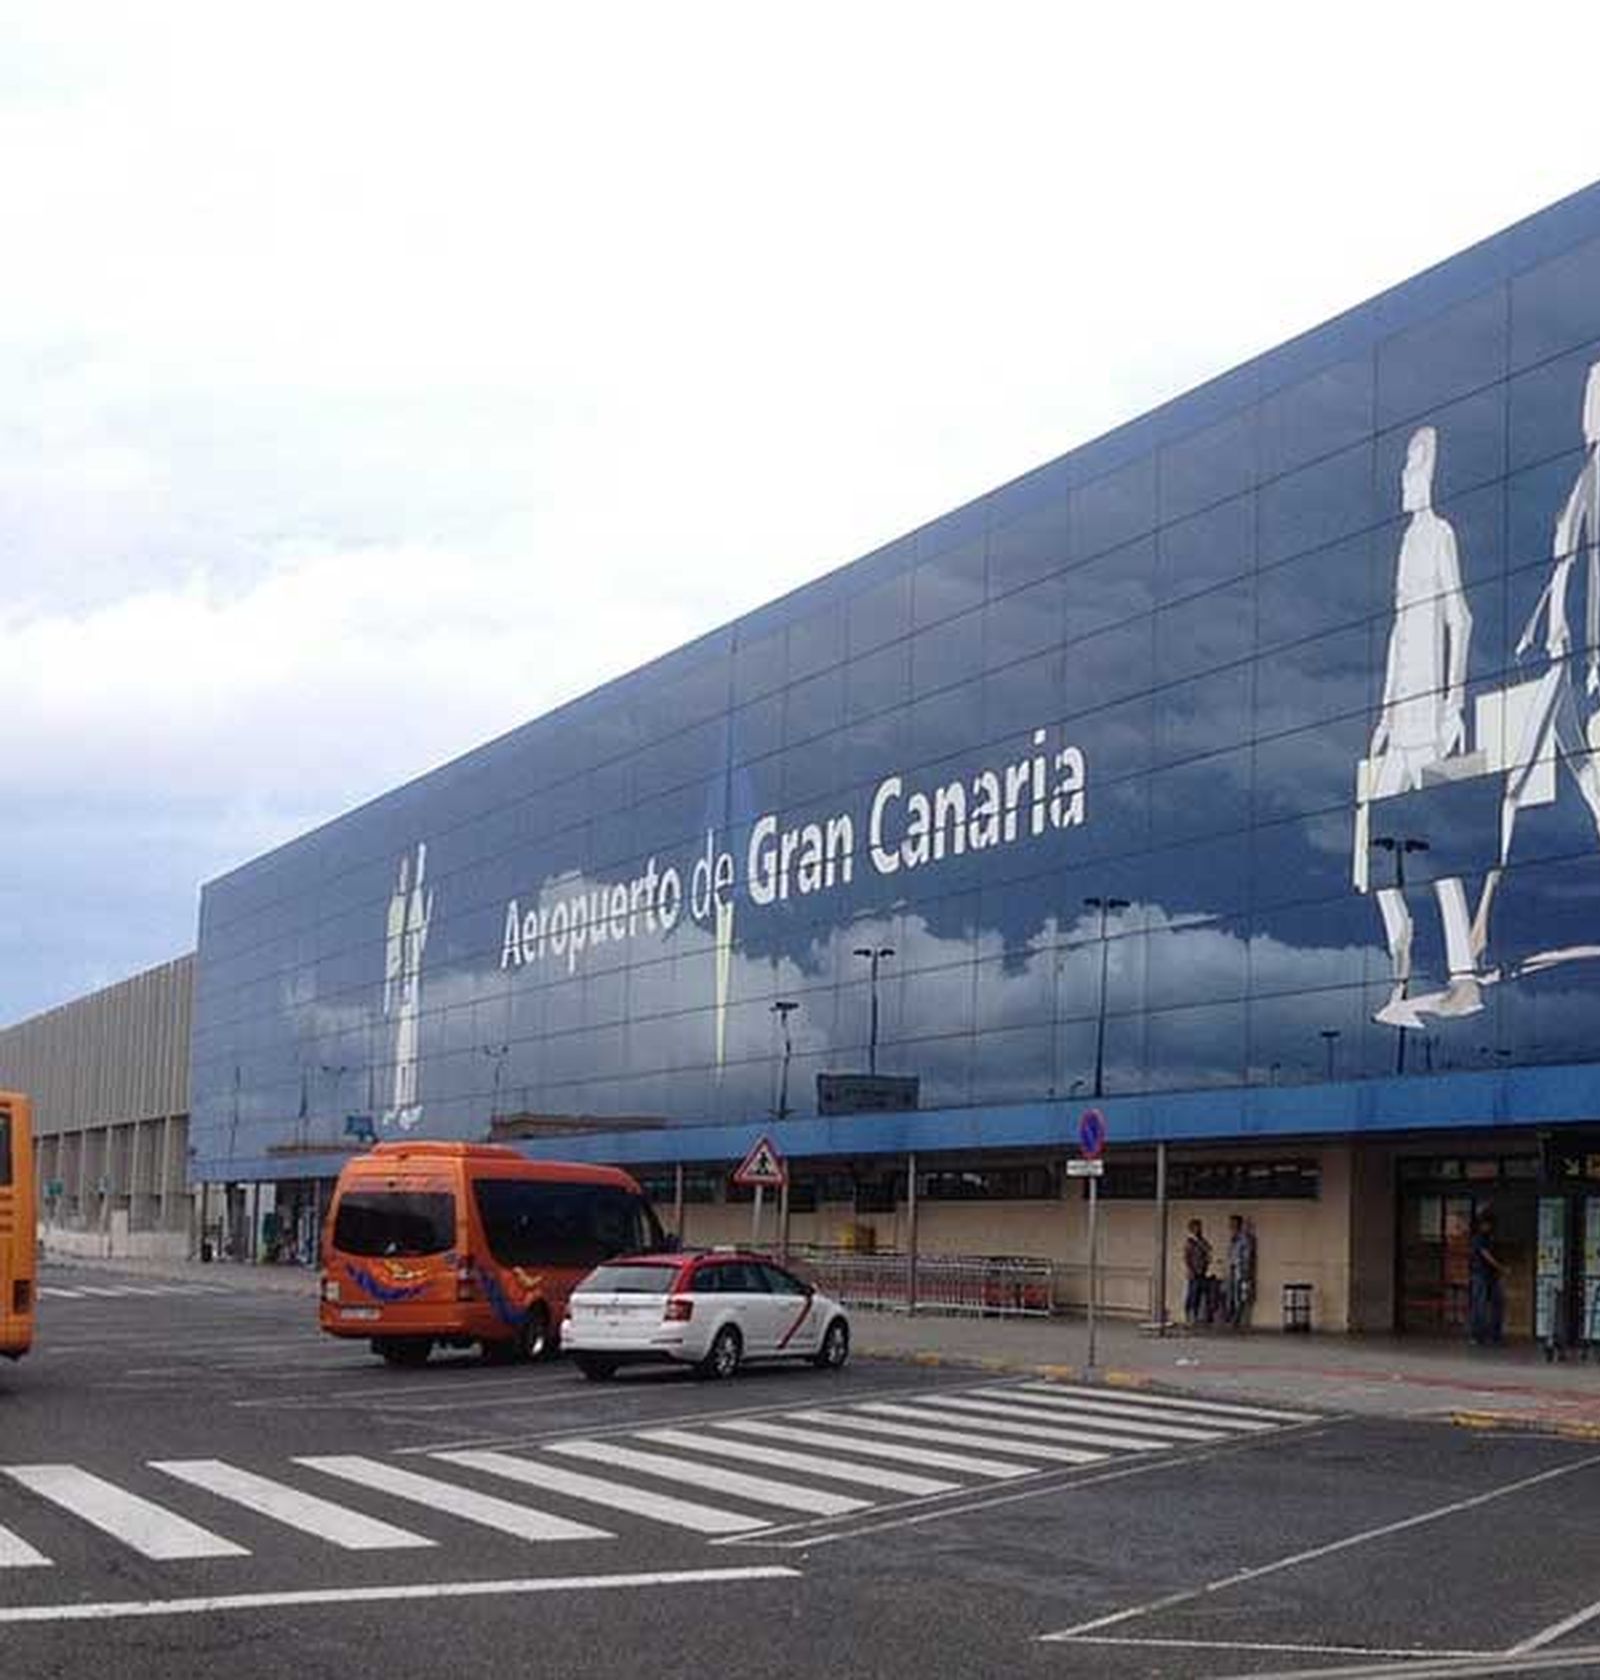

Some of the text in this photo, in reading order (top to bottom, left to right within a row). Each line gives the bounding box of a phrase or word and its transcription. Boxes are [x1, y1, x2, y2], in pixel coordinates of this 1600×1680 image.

[501, 729, 1086, 973] Aeropuerto de Gran Canaria
